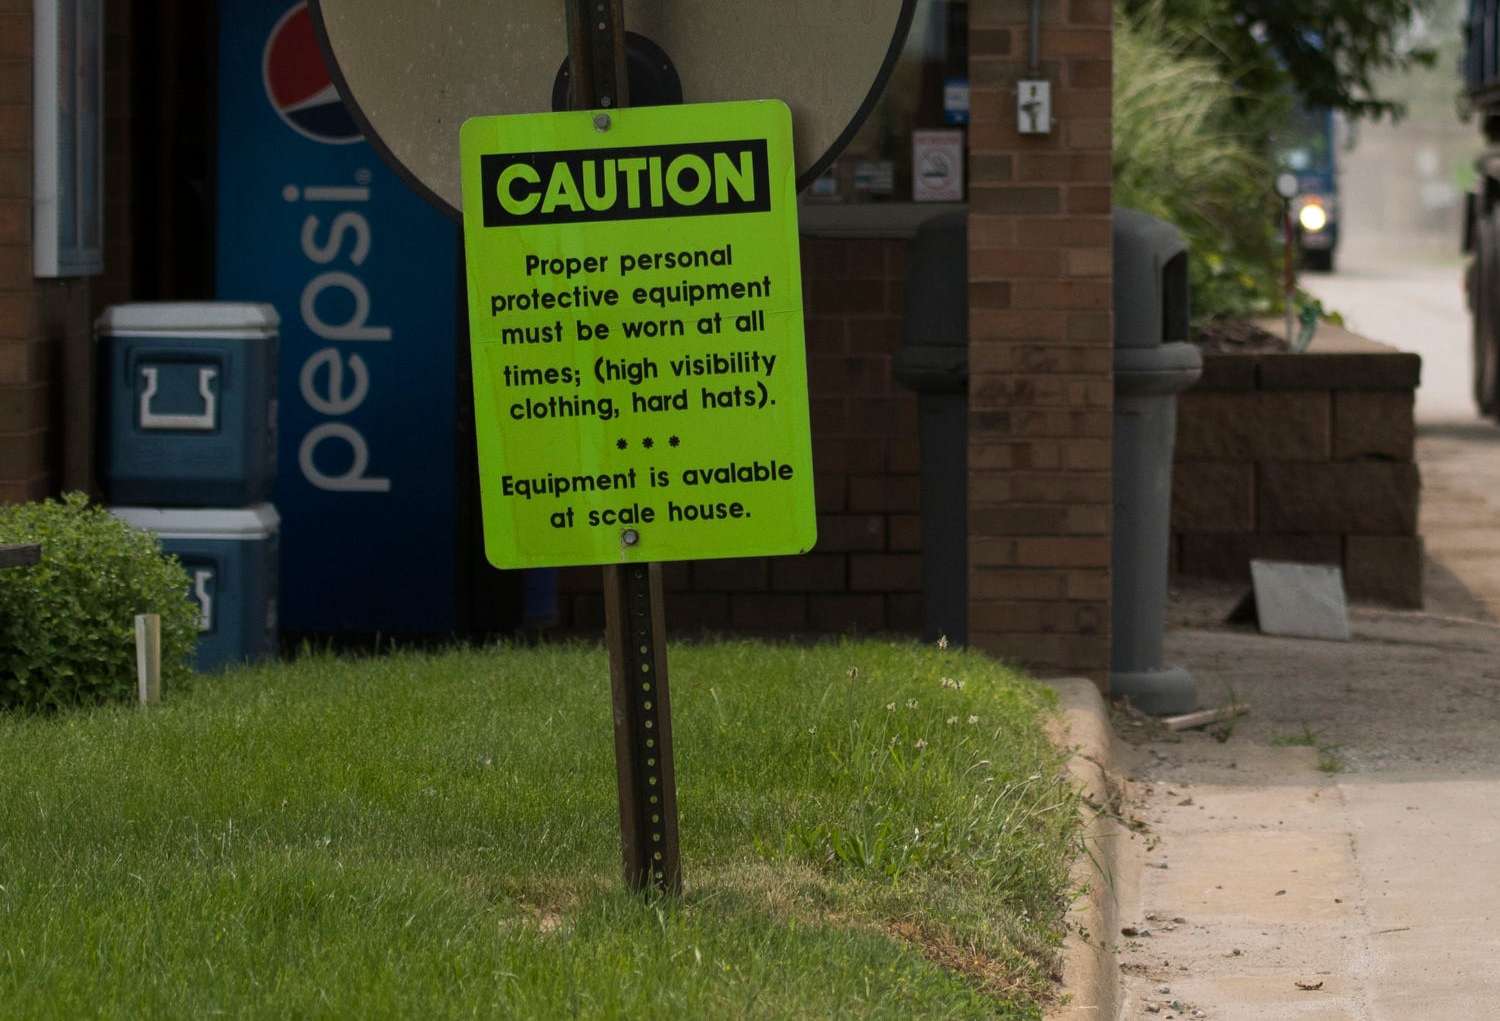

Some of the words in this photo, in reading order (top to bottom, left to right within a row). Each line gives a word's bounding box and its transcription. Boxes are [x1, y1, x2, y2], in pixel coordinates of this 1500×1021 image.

[496, 151, 756, 216] CAUTION
[526, 255, 608, 279] Proper
[621, 244, 731, 276] personal
[491, 286, 618, 316] protective
[633, 276, 770, 307] equipment
[283, 185, 392, 492] pepsi
[502, 321, 562, 344] must
[577, 320, 609, 340] be
[622, 320, 684, 338] worn
[697, 313, 721, 334] at
[736, 310, 764, 332] all
[504, 366, 580, 387] times;
[594, 357, 657, 385] (high
[670, 351, 776, 376] visibility
[510, 395, 619, 420] clothing,
[632, 389, 687, 412] hard
[702, 381, 775, 409] hats).
[502, 468, 636, 499] Equipment
[650, 467, 669, 487] is
[683, 461, 793, 485] avalable
[551, 507, 574, 528] at
[589, 503, 655, 526] scale
[669, 501, 750, 521] house.
